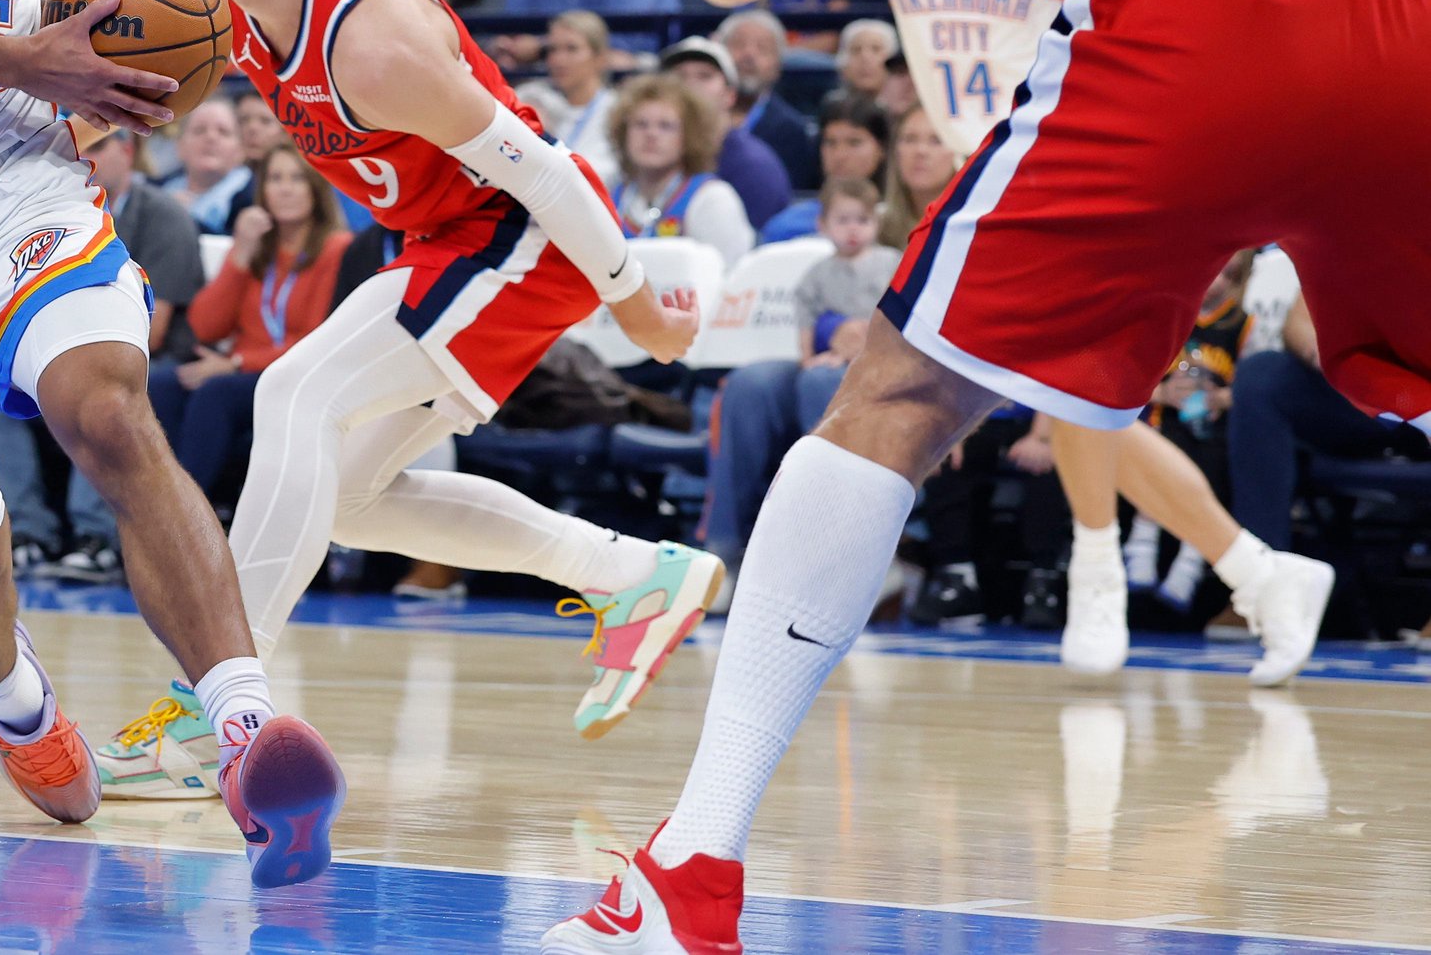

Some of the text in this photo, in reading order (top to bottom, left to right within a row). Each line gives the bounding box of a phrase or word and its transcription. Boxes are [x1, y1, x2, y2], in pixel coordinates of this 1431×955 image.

[931, 20, 990, 52] CITY
[270, 83, 315, 128] Los
[295, 84, 322, 95] VISIT
[934, 59, 1001, 119] 14
[348, 156, 400, 209] 9
